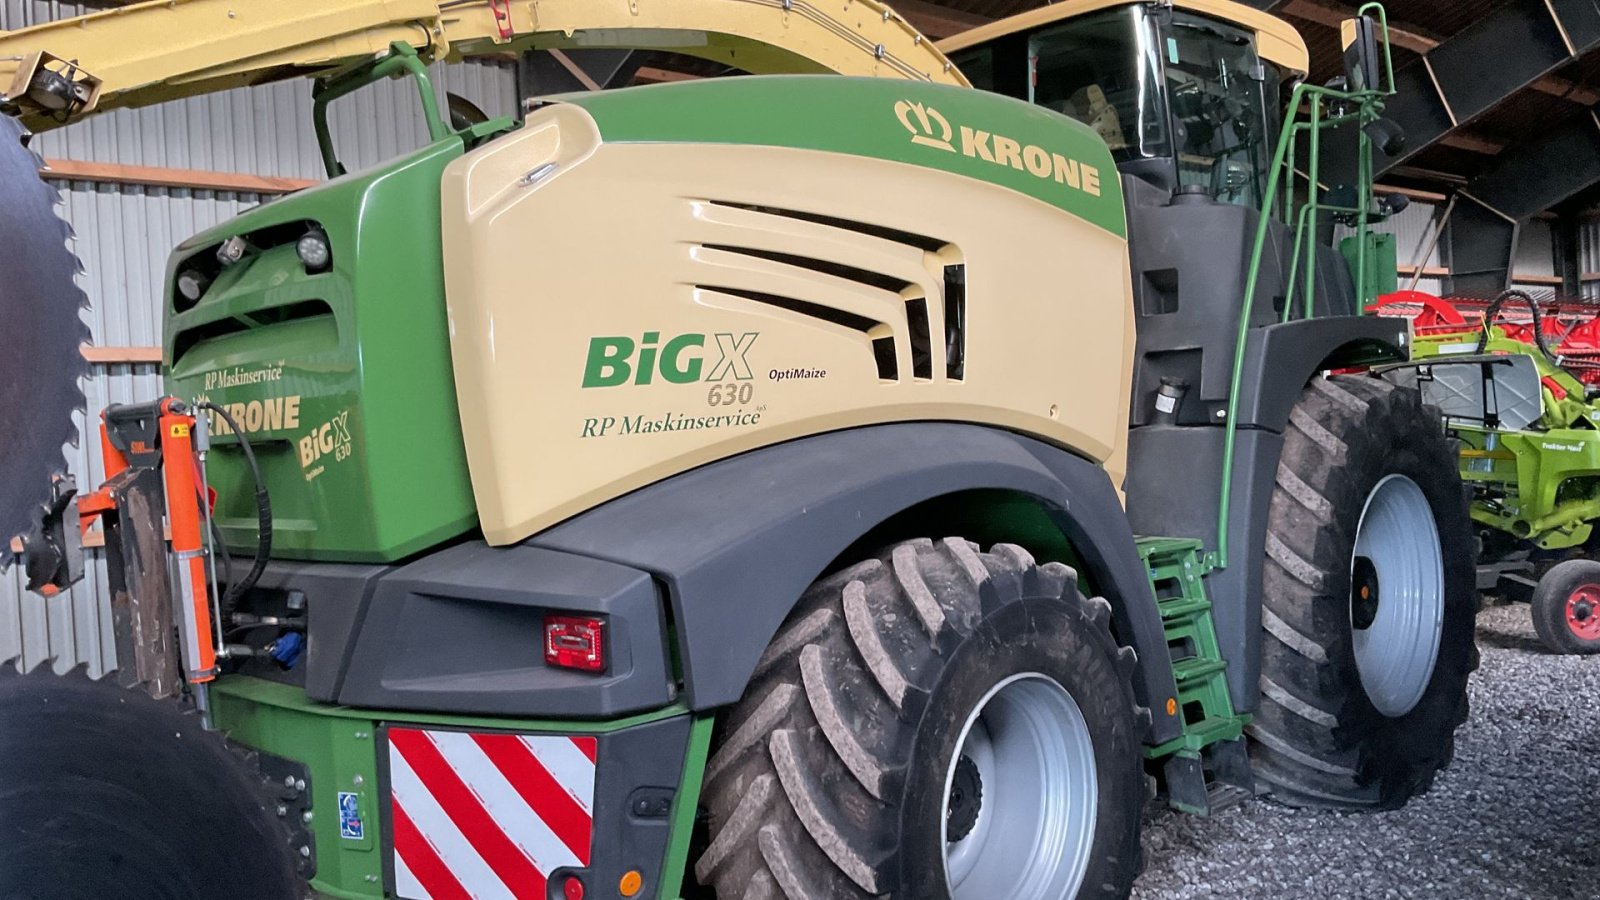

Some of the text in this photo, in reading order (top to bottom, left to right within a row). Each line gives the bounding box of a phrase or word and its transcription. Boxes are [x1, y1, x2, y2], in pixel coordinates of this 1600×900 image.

[960, 125, 1101, 197] KRONE
[205, 363, 282, 391] RP Maskinservice
[768, 367, 827, 382] OptiMaize
[707, 382, 754, 407] 630
[215, 395, 300, 436] KRONE
[580, 409, 761, 438] RP Maskinservice
[335, 442, 351, 462] 630
